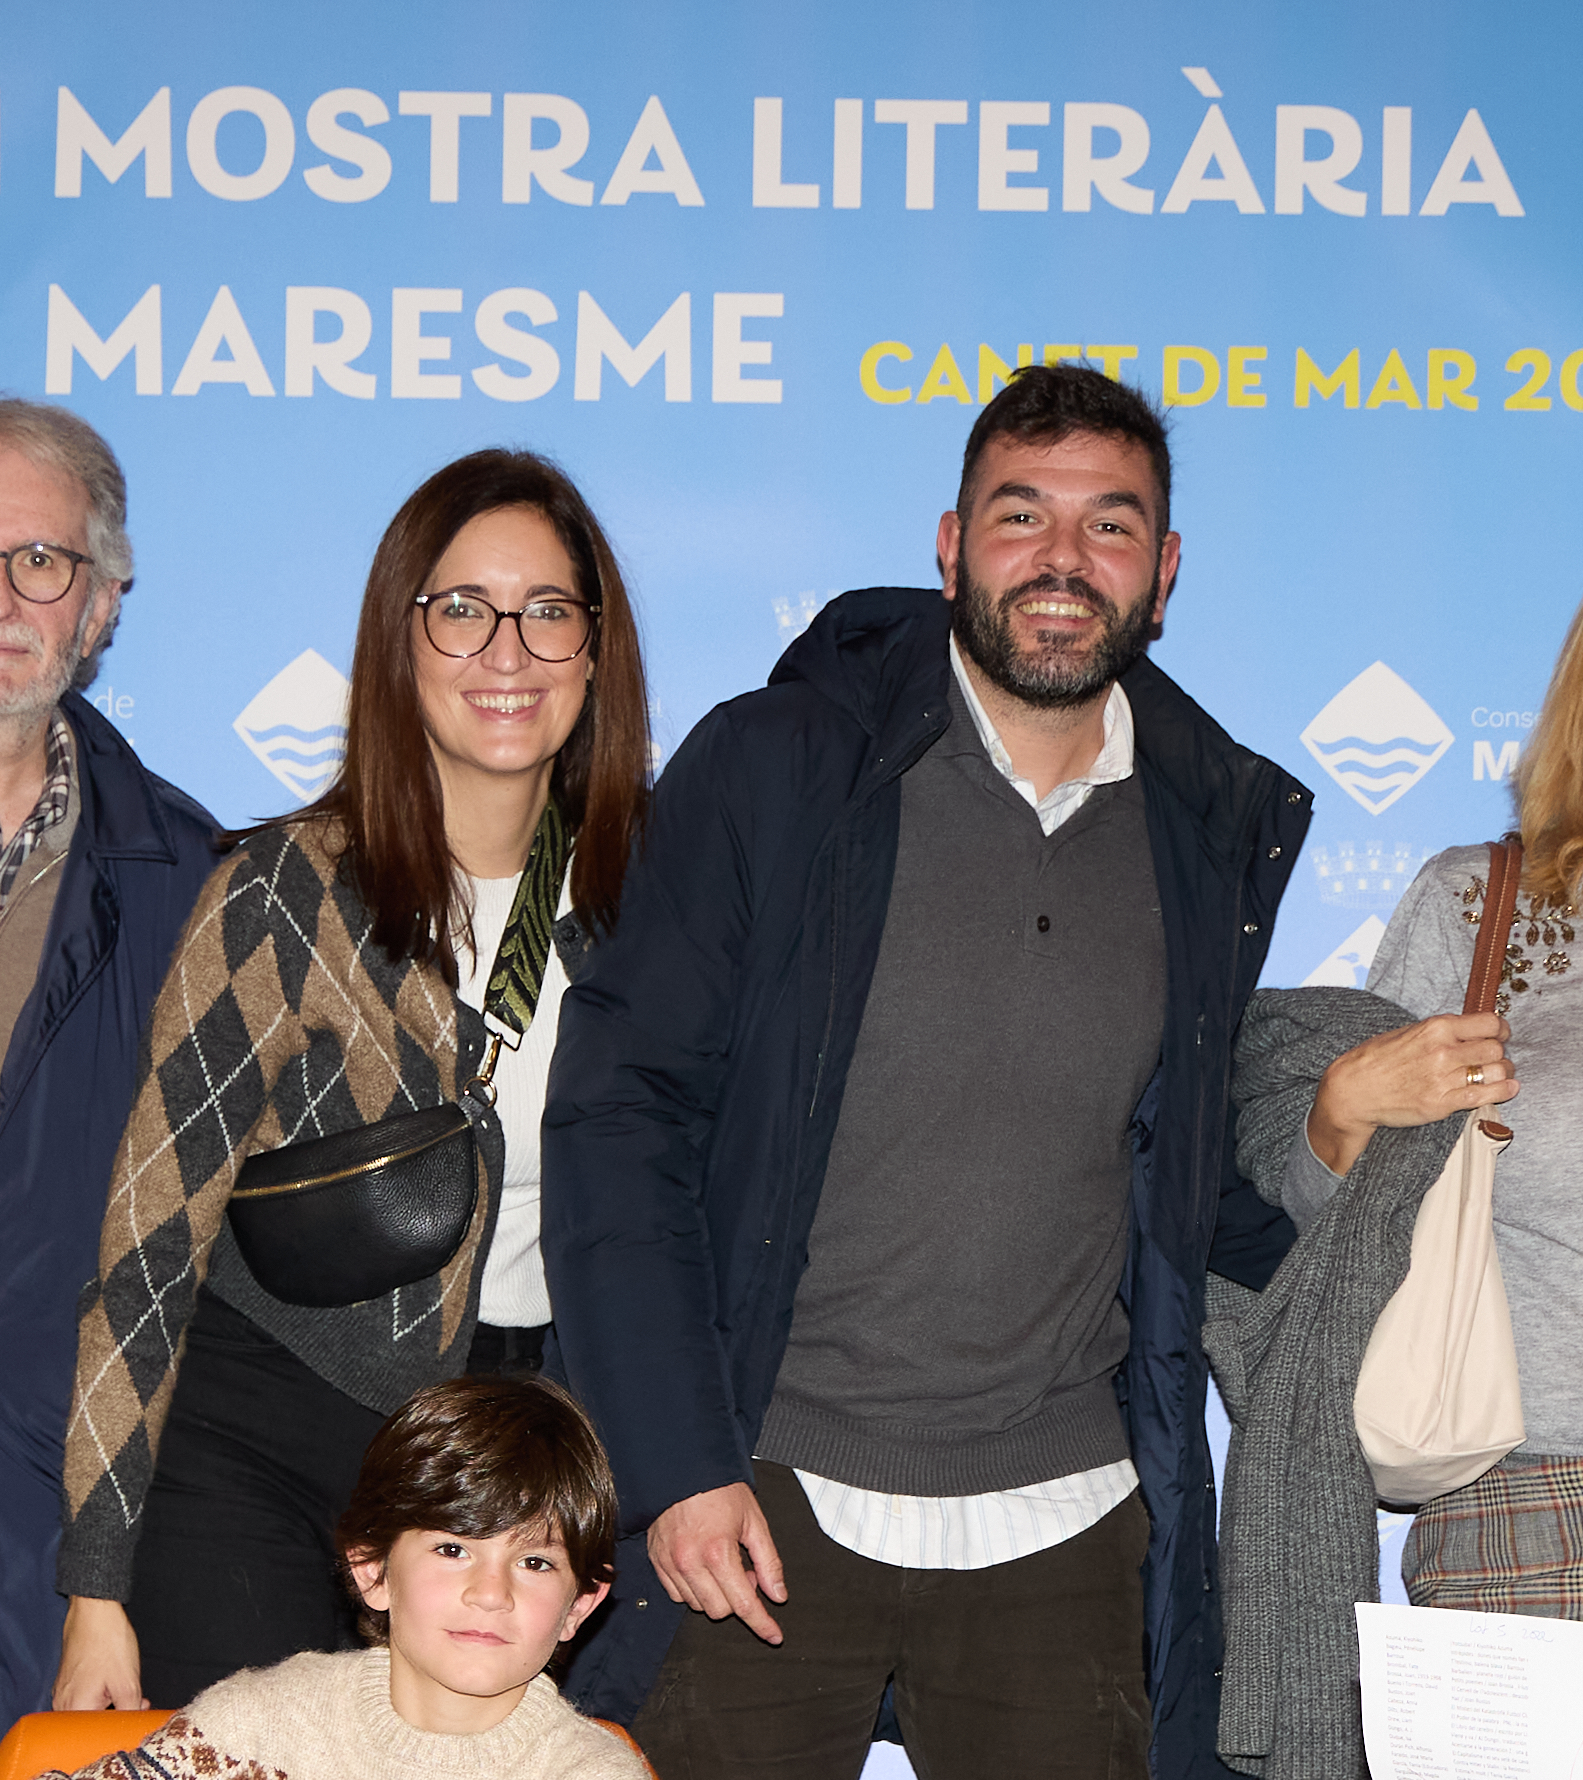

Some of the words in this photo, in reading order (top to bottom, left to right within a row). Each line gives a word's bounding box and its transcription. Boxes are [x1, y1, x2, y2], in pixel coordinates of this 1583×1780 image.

[54, 85, 705, 207] MOSTRA
[752, 66, 1525, 217] LITERÀRIA
[45, 283, 784, 404] MARESME
[1162, 346, 1267, 407] DE
[1294, 347, 1479, 411] MAR
